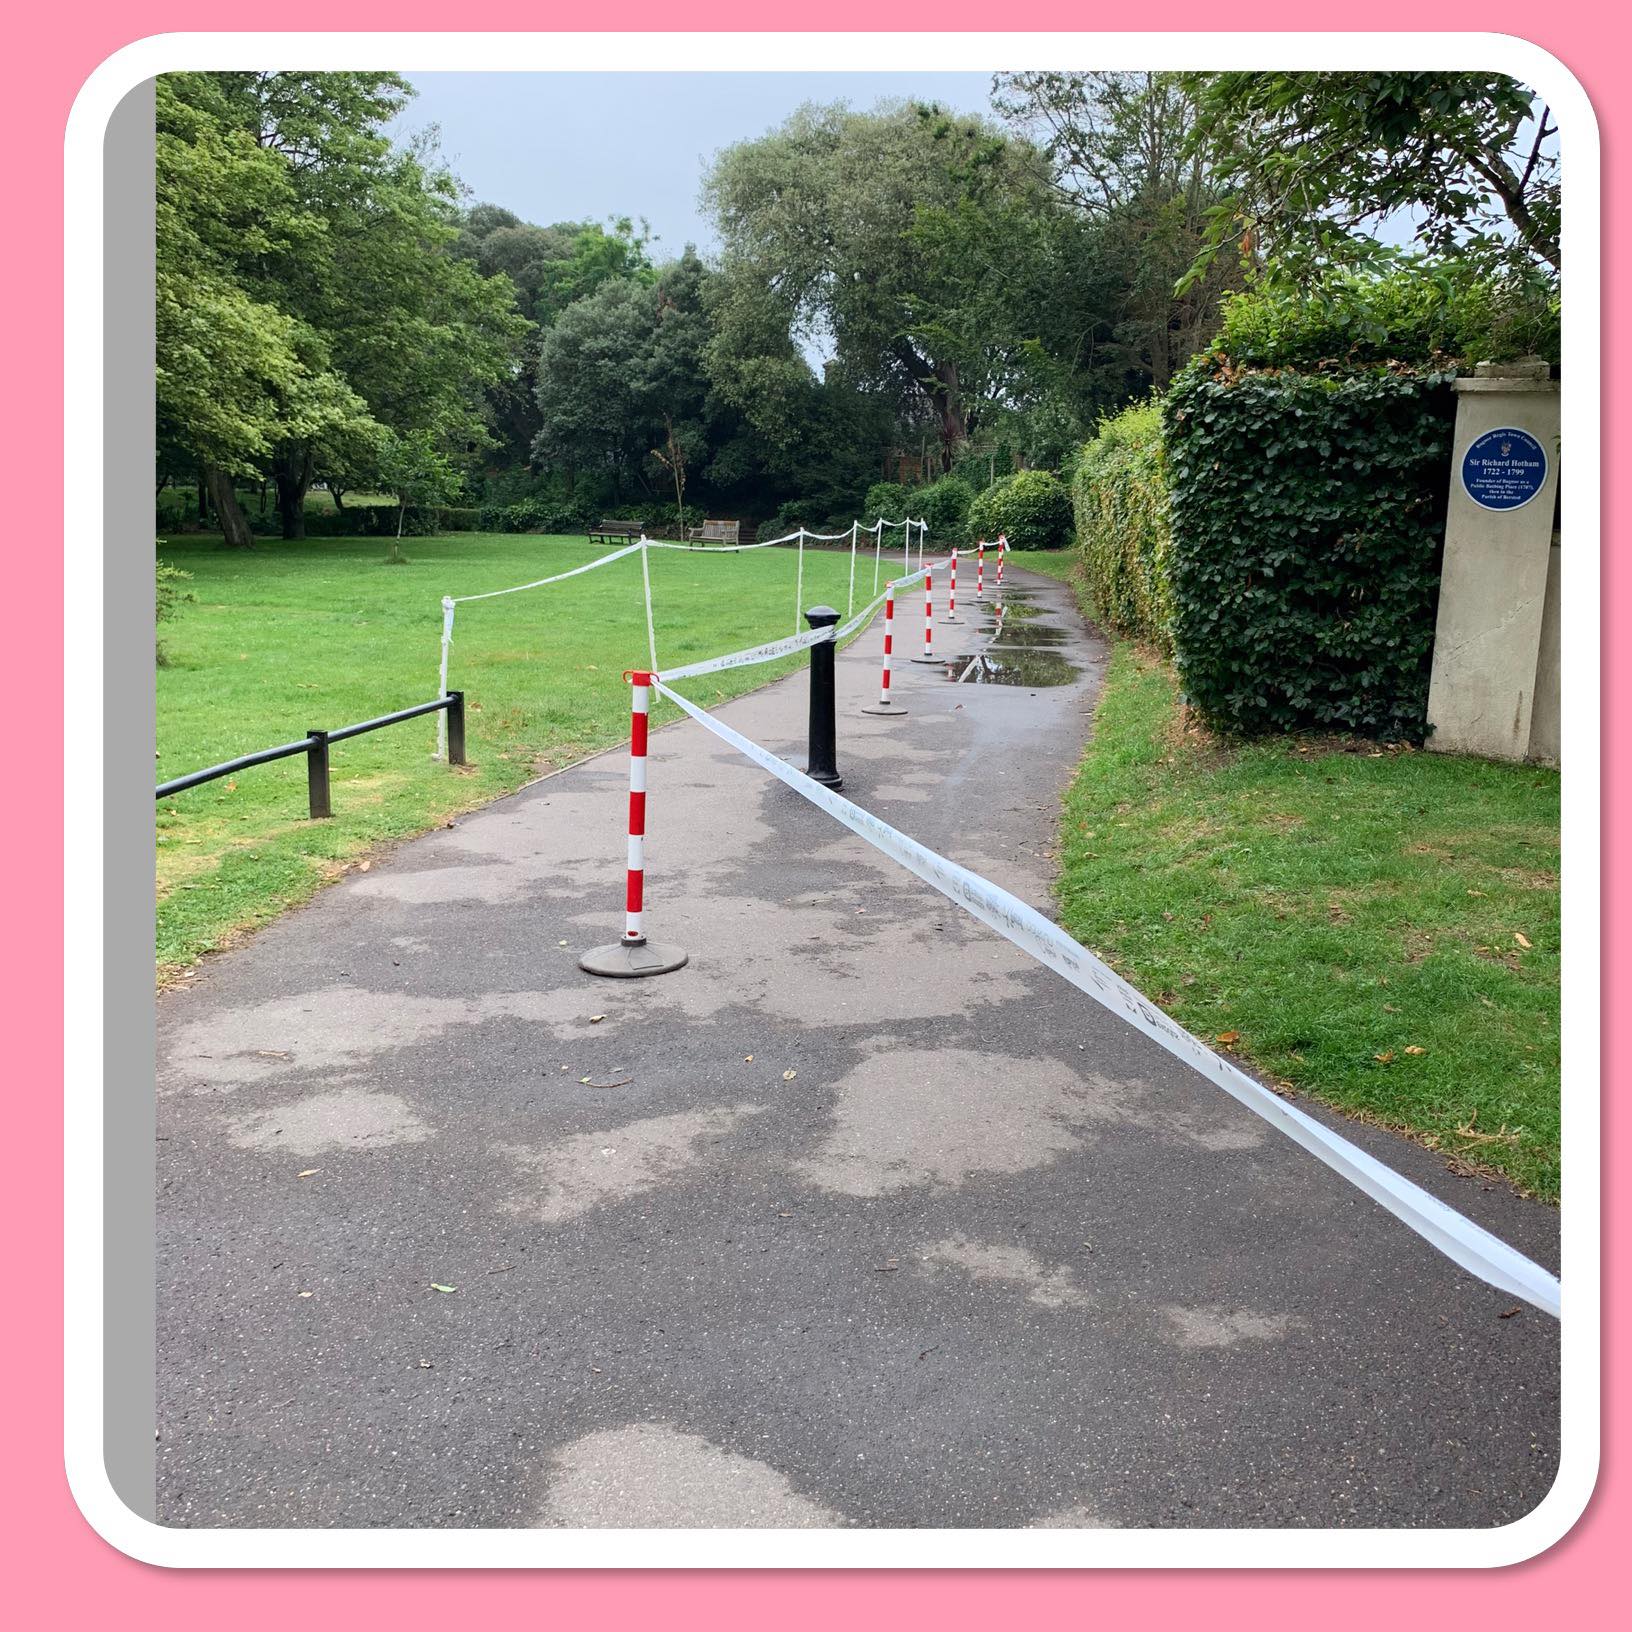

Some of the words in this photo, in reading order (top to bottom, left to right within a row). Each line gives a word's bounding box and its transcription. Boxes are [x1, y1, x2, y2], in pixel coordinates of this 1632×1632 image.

[1482, 459, 1510, 467] Richard
[1511, 459, 1540, 467] Hotham
[1507, 468, 1525, 476] 1799
